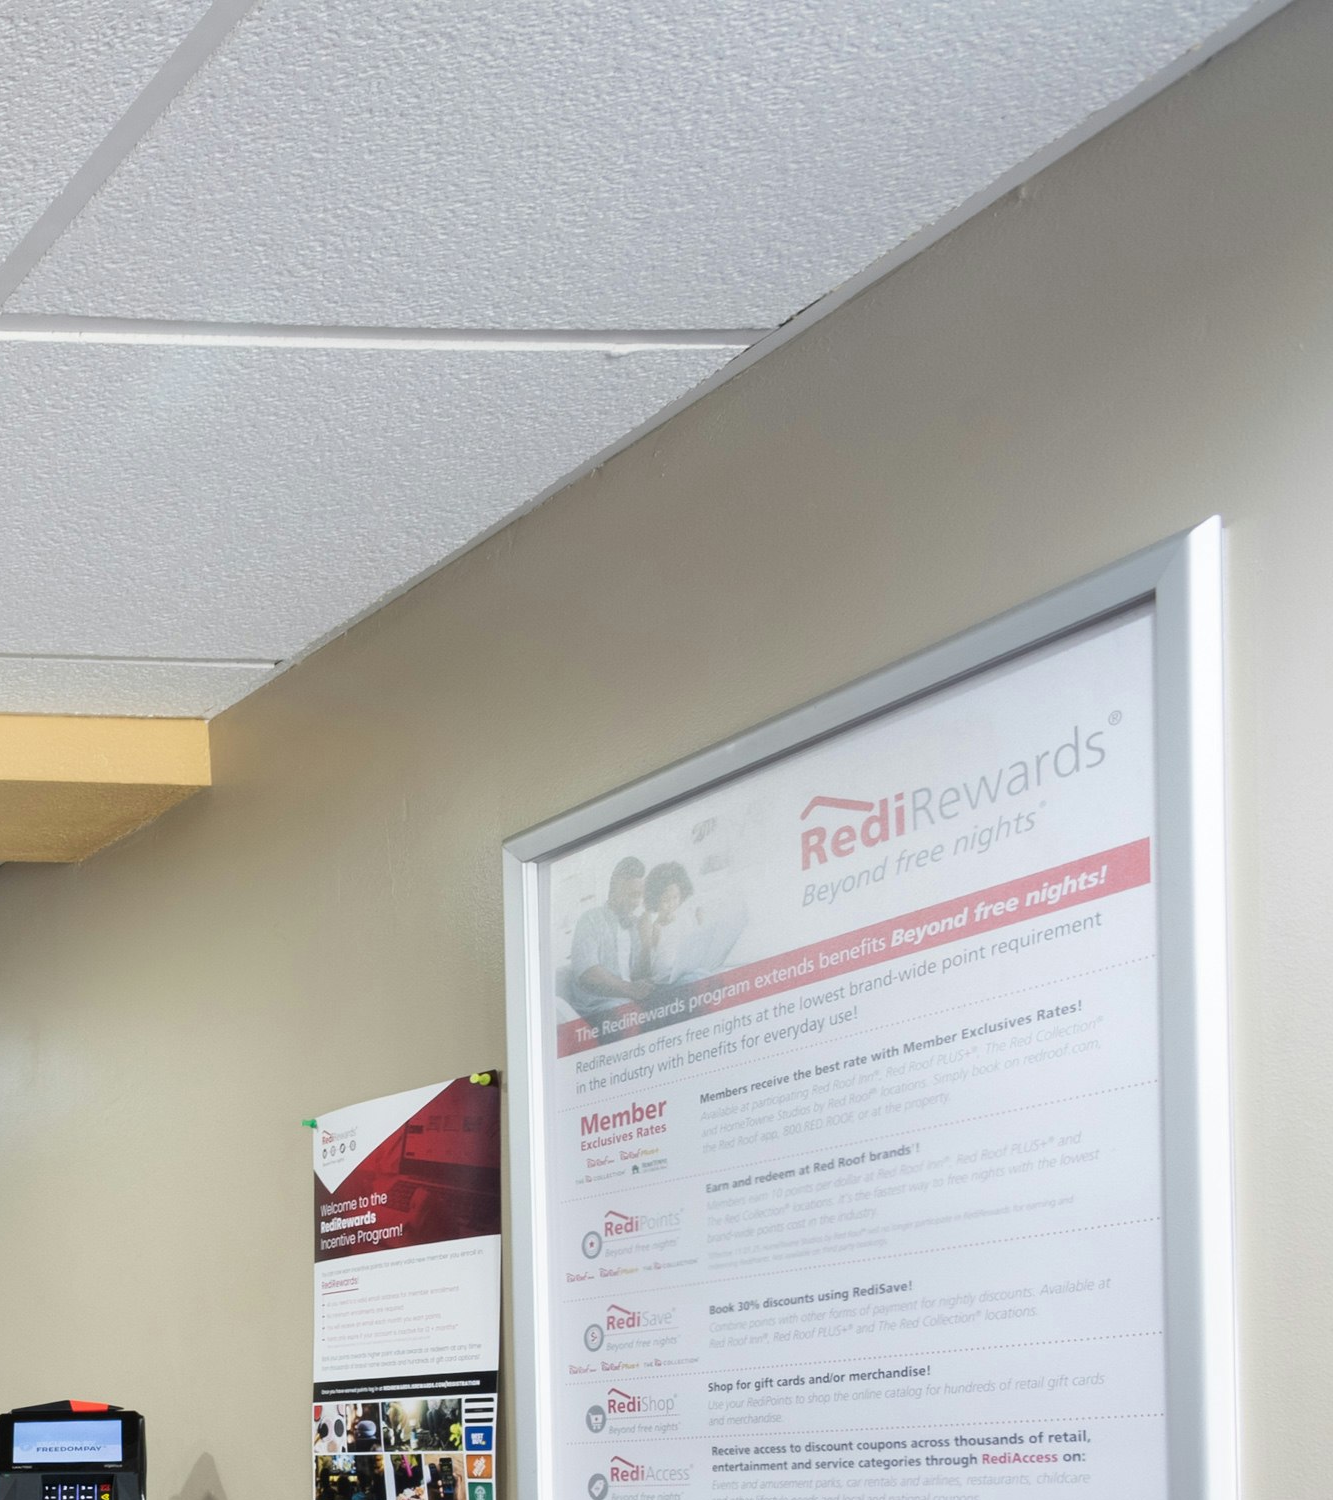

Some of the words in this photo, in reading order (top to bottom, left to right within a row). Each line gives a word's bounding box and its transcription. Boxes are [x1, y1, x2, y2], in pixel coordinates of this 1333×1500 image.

[802, 859, 887, 907] Beyond
[896, 840, 945, 876] free
[574, 1025, 599, 1042] The
[601, 997, 685, 1035] RediRewards
[688, 979, 750, 1012] program
[753, 956, 814, 988] extends
[818, 936, 886, 968] benefits
[890, 906, 968, 947] Beyond
[973, 896, 1019, 922] free
[1024, 864, 1107, 907] nights!
[575, 1042, 646, 1074] RediRewards
[647, 1034, 683, 1053] offers
[684, 1026, 710, 1042] free
[712, 1013, 752, 1036] nights
[755, 1007, 769, 1023] at
[771, 1001, 795, 1018] the
[798, 985, 845, 1010] lowest
[848, 959, 937, 996] brand-wide
[941, 945, 986, 974] point
[990, 911, 1102, 956] requirement
[575, 1082, 586, 1094] in
[587, 1076, 607, 1091] the
[609, 1063, 655, 1085] industry
[656, 1053, 684, 1072] with
[687, 1040, 738, 1064] benefits
[739, 1034, 760, 1050] for
[762, 1016, 825, 1044] everyday
[828, 1004, 857, 1026] use!
[699, 1084, 748, 1104] Members
[749, 1074, 790, 1092] receive
[792, 1068, 812, 1081] the
[813, 1060, 840, 1076] best
[842, 1055, 867, 1069] rate
[870, 1045, 899, 1062] with
[902, 1032, 957, 1054] Member
[961, 1014, 1032, 1040] Exclusives
[1036, 999, 1081, 1021] Rates!
[580, 1099, 667, 1136] Member
[580, 1130, 633, 1152] Exclusives
[635, 1122, 667, 1138] Rates
[320, 1199, 357, 1217] Welcome
[358, 1196, 369, 1208] to
[370, 1192, 388, 1206] the
[320, 1211, 376, 1233] RediRewards
[320, 1233, 355, 1250] Incentive
[357, 1223, 403, 1245] Program!
[708, 1302, 734, 1315] Book
[737, 1299, 760, 1312] 30%
[761, 1293, 814, 1308] discounts
[817, 1289, 849, 1302] using
[851, 1279, 912, 1297] RediSave!
[707, 1381, 733, 1393] Shop
[735, 1378, 751, 1390] for
[753, 1376, 773, 1392] gift
[775, 1374, 805, 1387] cards
[807, 1371, 845, 1385] and/or
[848, 1364, 930, 1381] merchandise!
[711, 1445, 751, 1456] Receive
[752, 1444, 787, 1455] access
[788, 1442, 802, 1453] to
[803, 1440, 853, 1452] discount
[855, 1439, 907, 1452] coupons
[909, 1438, 950, 1448] across
[953, 1432, 1025, 1447] thousands
[1028, 1430, 1044, 1444] of
[1047, 1428, 1091, 1443] retail,
[711, 1460, 788, 1472] entertainment
[790, 1458, 812, 1470] and
[814, 1457, 855, 1470] service
[857, 1457, 922, 1470] categories
[924, 1453, 978, 1468] through
[981, 1452, 1058, 1464] RediAccess
[1061, 1452, 1085, 1462] on:
